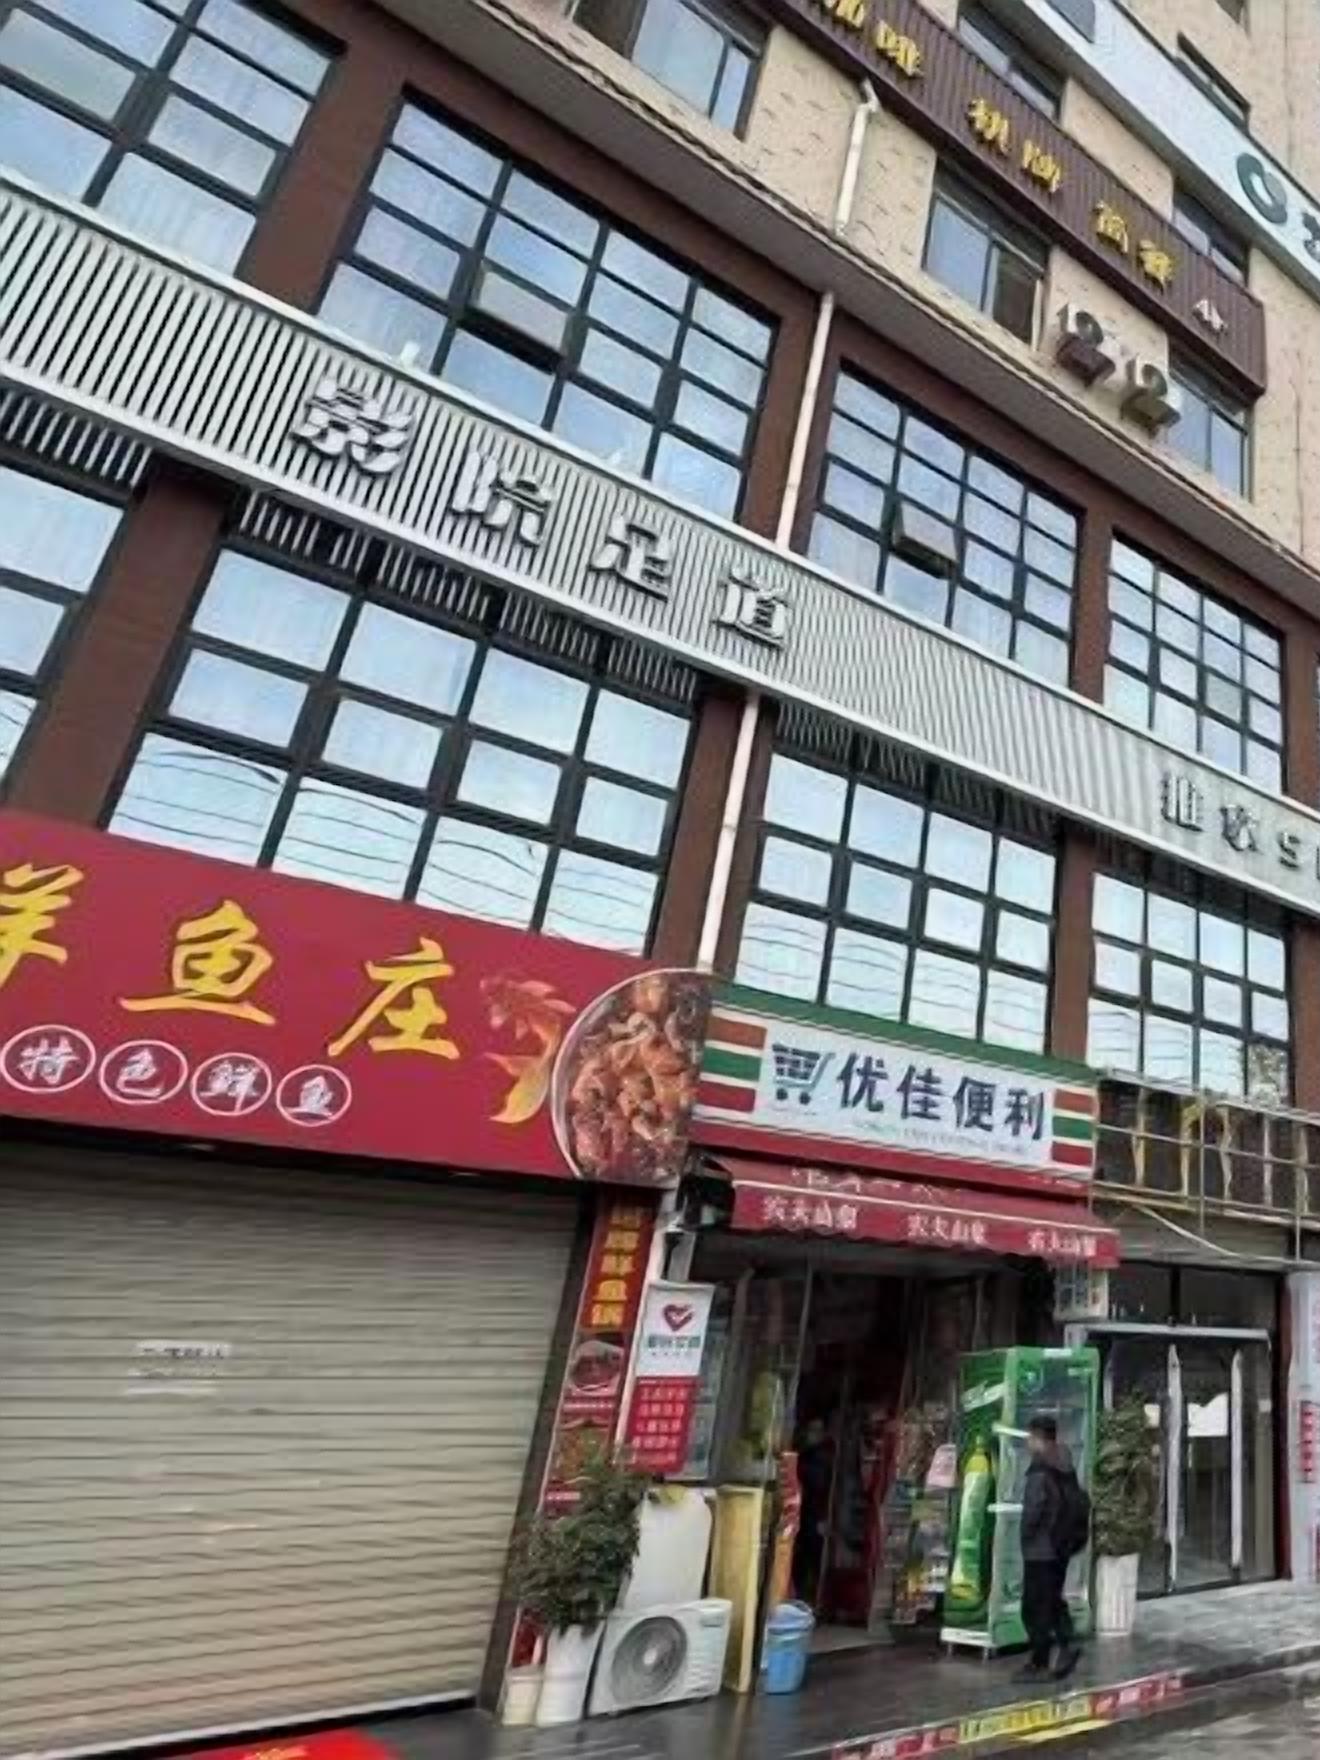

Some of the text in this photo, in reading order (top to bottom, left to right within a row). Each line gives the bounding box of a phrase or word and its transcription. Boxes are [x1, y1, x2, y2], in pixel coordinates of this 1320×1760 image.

[291, 376, 790, 651] 影院足道
[18, 1036, 333, 1118] 特色鲜鱼
[835, 1051, 1045, 1141] 优佳便利
